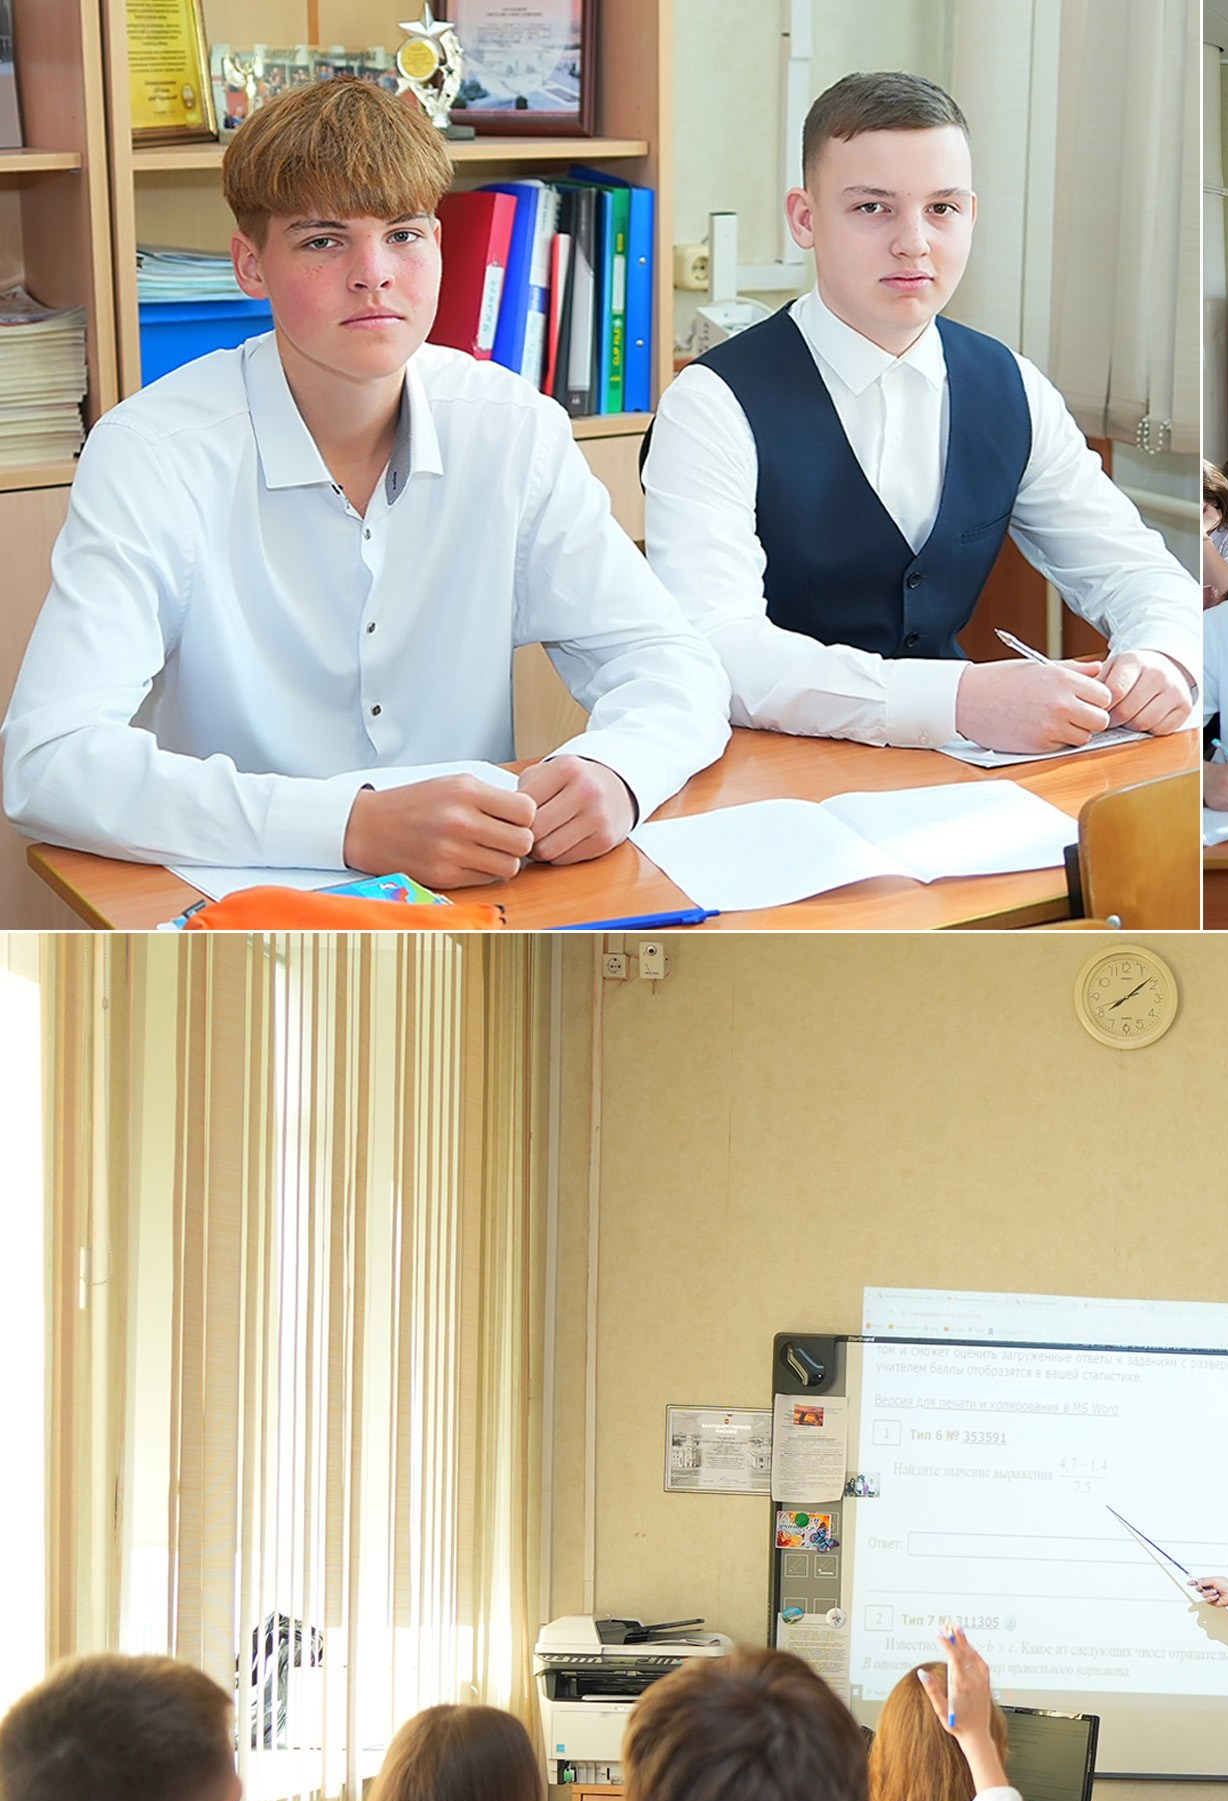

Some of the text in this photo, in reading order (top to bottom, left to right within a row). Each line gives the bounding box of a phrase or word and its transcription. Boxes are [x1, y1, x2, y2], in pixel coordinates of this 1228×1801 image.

[910, 1346, 950, 1357] сможет
[953, 1348, 997, 1361] оценить
[1001, 1350, 1072, 1365] загруженные
[1075, 1353, 1114, 1365] ответы
[875, 1361, 927, 1373] учителем
[929, 1361, 964, 1374] баллы
[967, 1363, 1032, 1378] отобразятся
[1045, 1367, 1079, 1379] вашей
[874, 1394, 913, 1407] Версия
[916, 1398, 936, 1408] для
[940, 1399, 976, 1409] печати
[990, 1401, 1059, 1413] копирования
[1072, 1402, 1088, 1413] MS
[1091, 1403, 1119, 1416] Word
[910, 1429, 932, 1440] Тип
[935, 1429, 942, 1440] 6
[946, 1430, 960, 1440] №
[963, 1431, 1007, 1445] 353591
[893, 1462, 1054, 1482] Найдите значение выражения
[868, 1536, 903, 1550] Ответ:
[901, 1614, 923, 1626] Тип
[927, 1615, 935, 1626] 7
[1020, 1641, 1052, 1655] Какое
[1055, 1646, 1068, 1656] из
[1070, 1646, 1132, 1660] следующих
[1135, 1648, 1165, 1659] чисел
[862, 1657, 871, 1670] В
[1008, 1662, 1073, 1676] правильного
